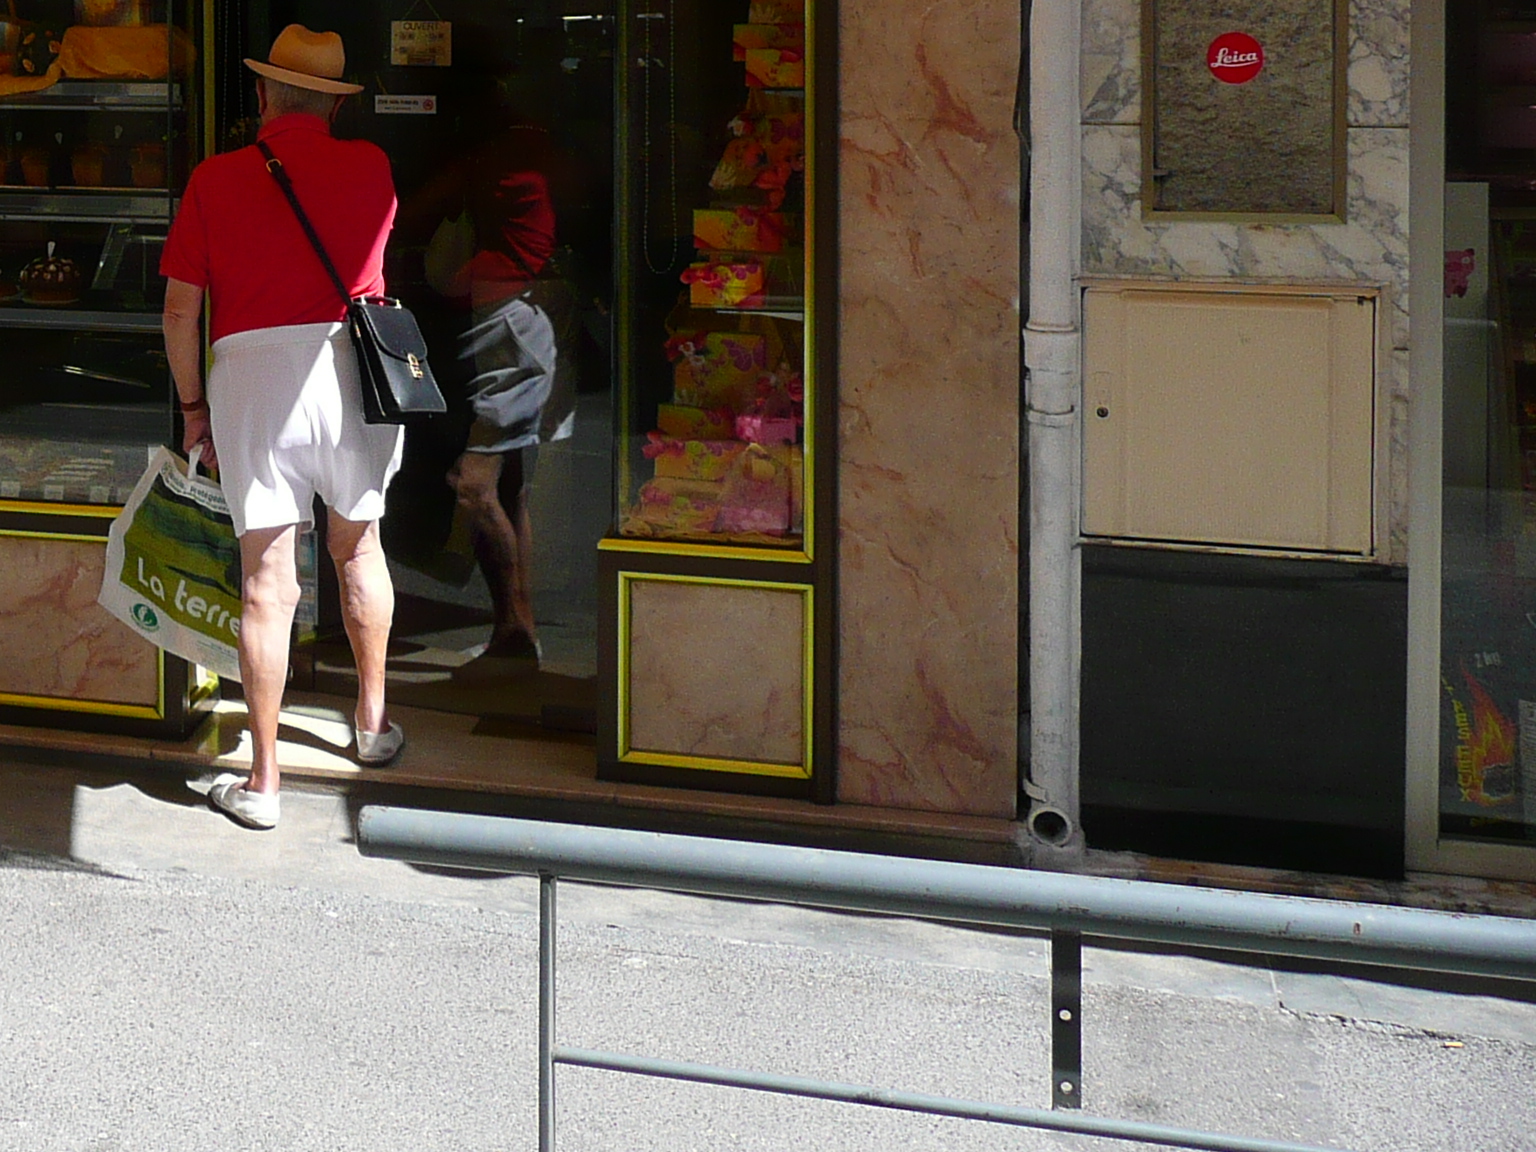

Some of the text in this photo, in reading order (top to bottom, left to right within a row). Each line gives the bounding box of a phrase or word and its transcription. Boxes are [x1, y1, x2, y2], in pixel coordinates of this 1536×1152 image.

[402, 22, 440, 31] OUVERT
[1209, 47, 1260, 68] Leica
[137, 556, 166, 602] La
[174, 579, 241, 639] terre
